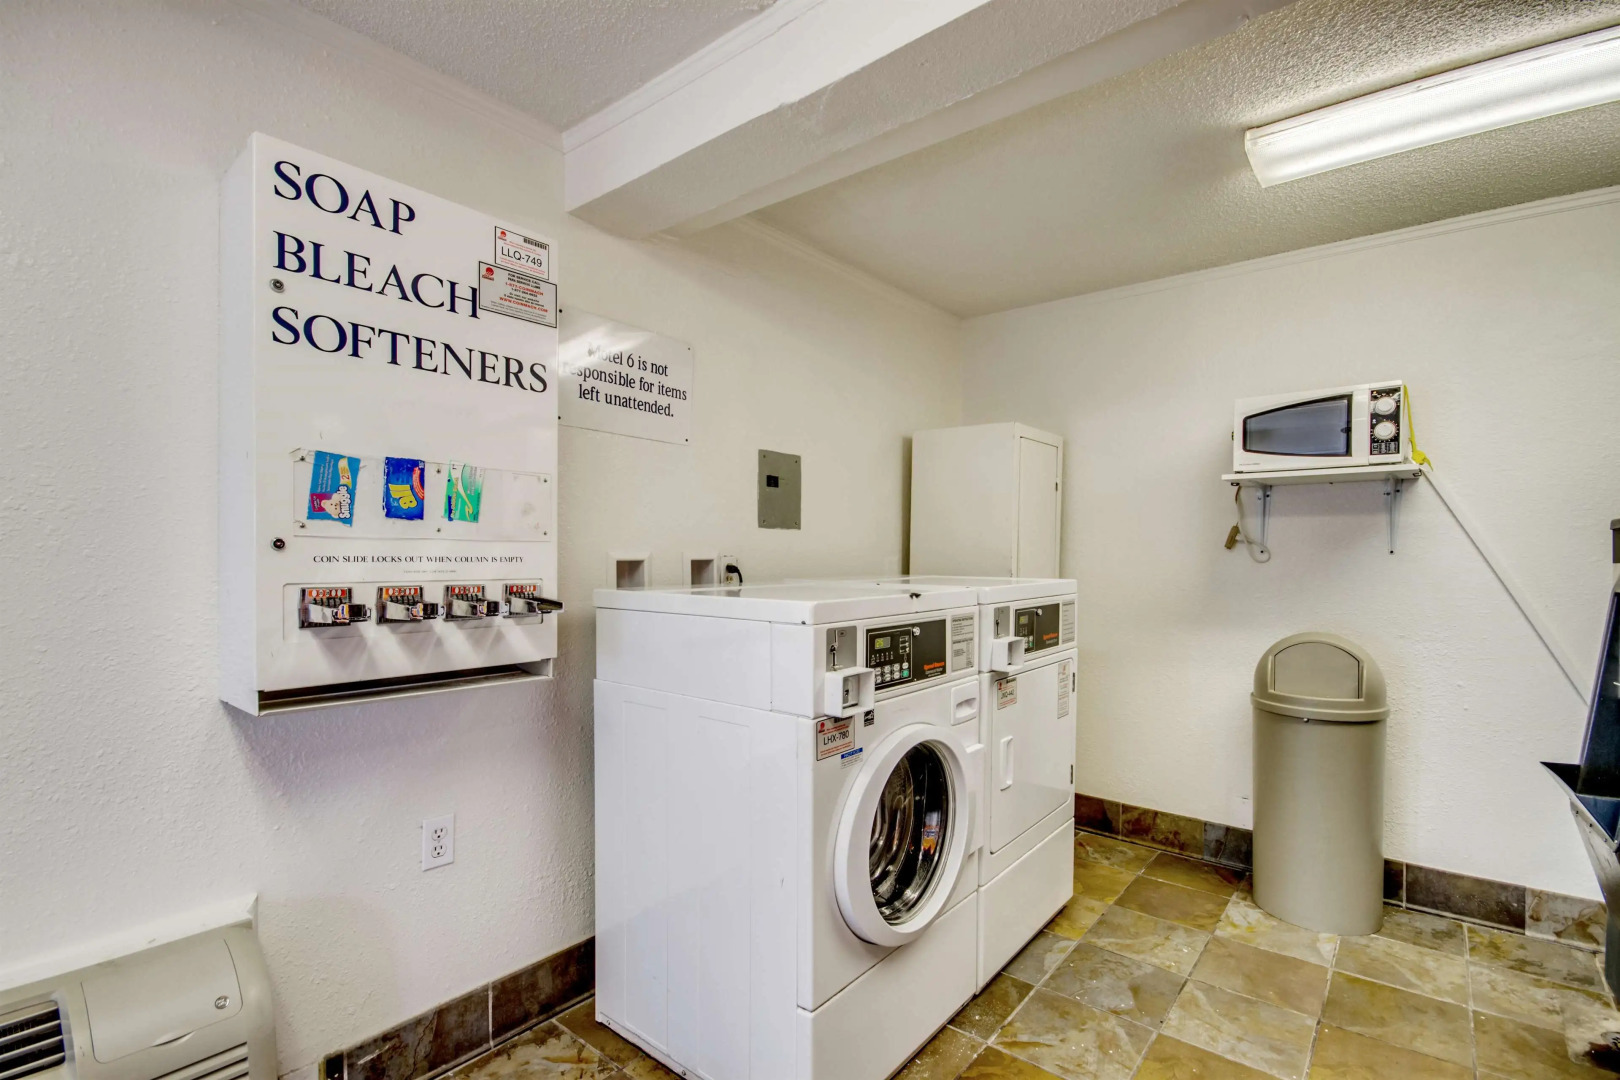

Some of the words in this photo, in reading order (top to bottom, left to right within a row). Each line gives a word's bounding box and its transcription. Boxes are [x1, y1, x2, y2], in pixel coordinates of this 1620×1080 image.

[274, 161, 416, 236] SOAP
[501, 246, 543, 268] LLQ-749
[273, 230, 480, 319] BLEACH
[271, 306, 548, 393] SOFTENERS
[587, 342, 623, 366] Motel
[626, 353, 635, 368] 6
[637, 356, 647, 371] is
[650, 362, 668, 377] not
[579, 384, 601, 402] left
[604, 392, 674, 418] unattended.
[639, 377, 655, 393] for
[657, 381, 688, 401] items
[336, 485, 351, 519] Snuggle
[313, 555, 340, 563] COIN
[342, 555, 369, 563] SLIDE
[371, 555, 402, 563] LOCKS
[404, 555, 424, 563] OUT
[823, 730, 850, 746] LHX-780
